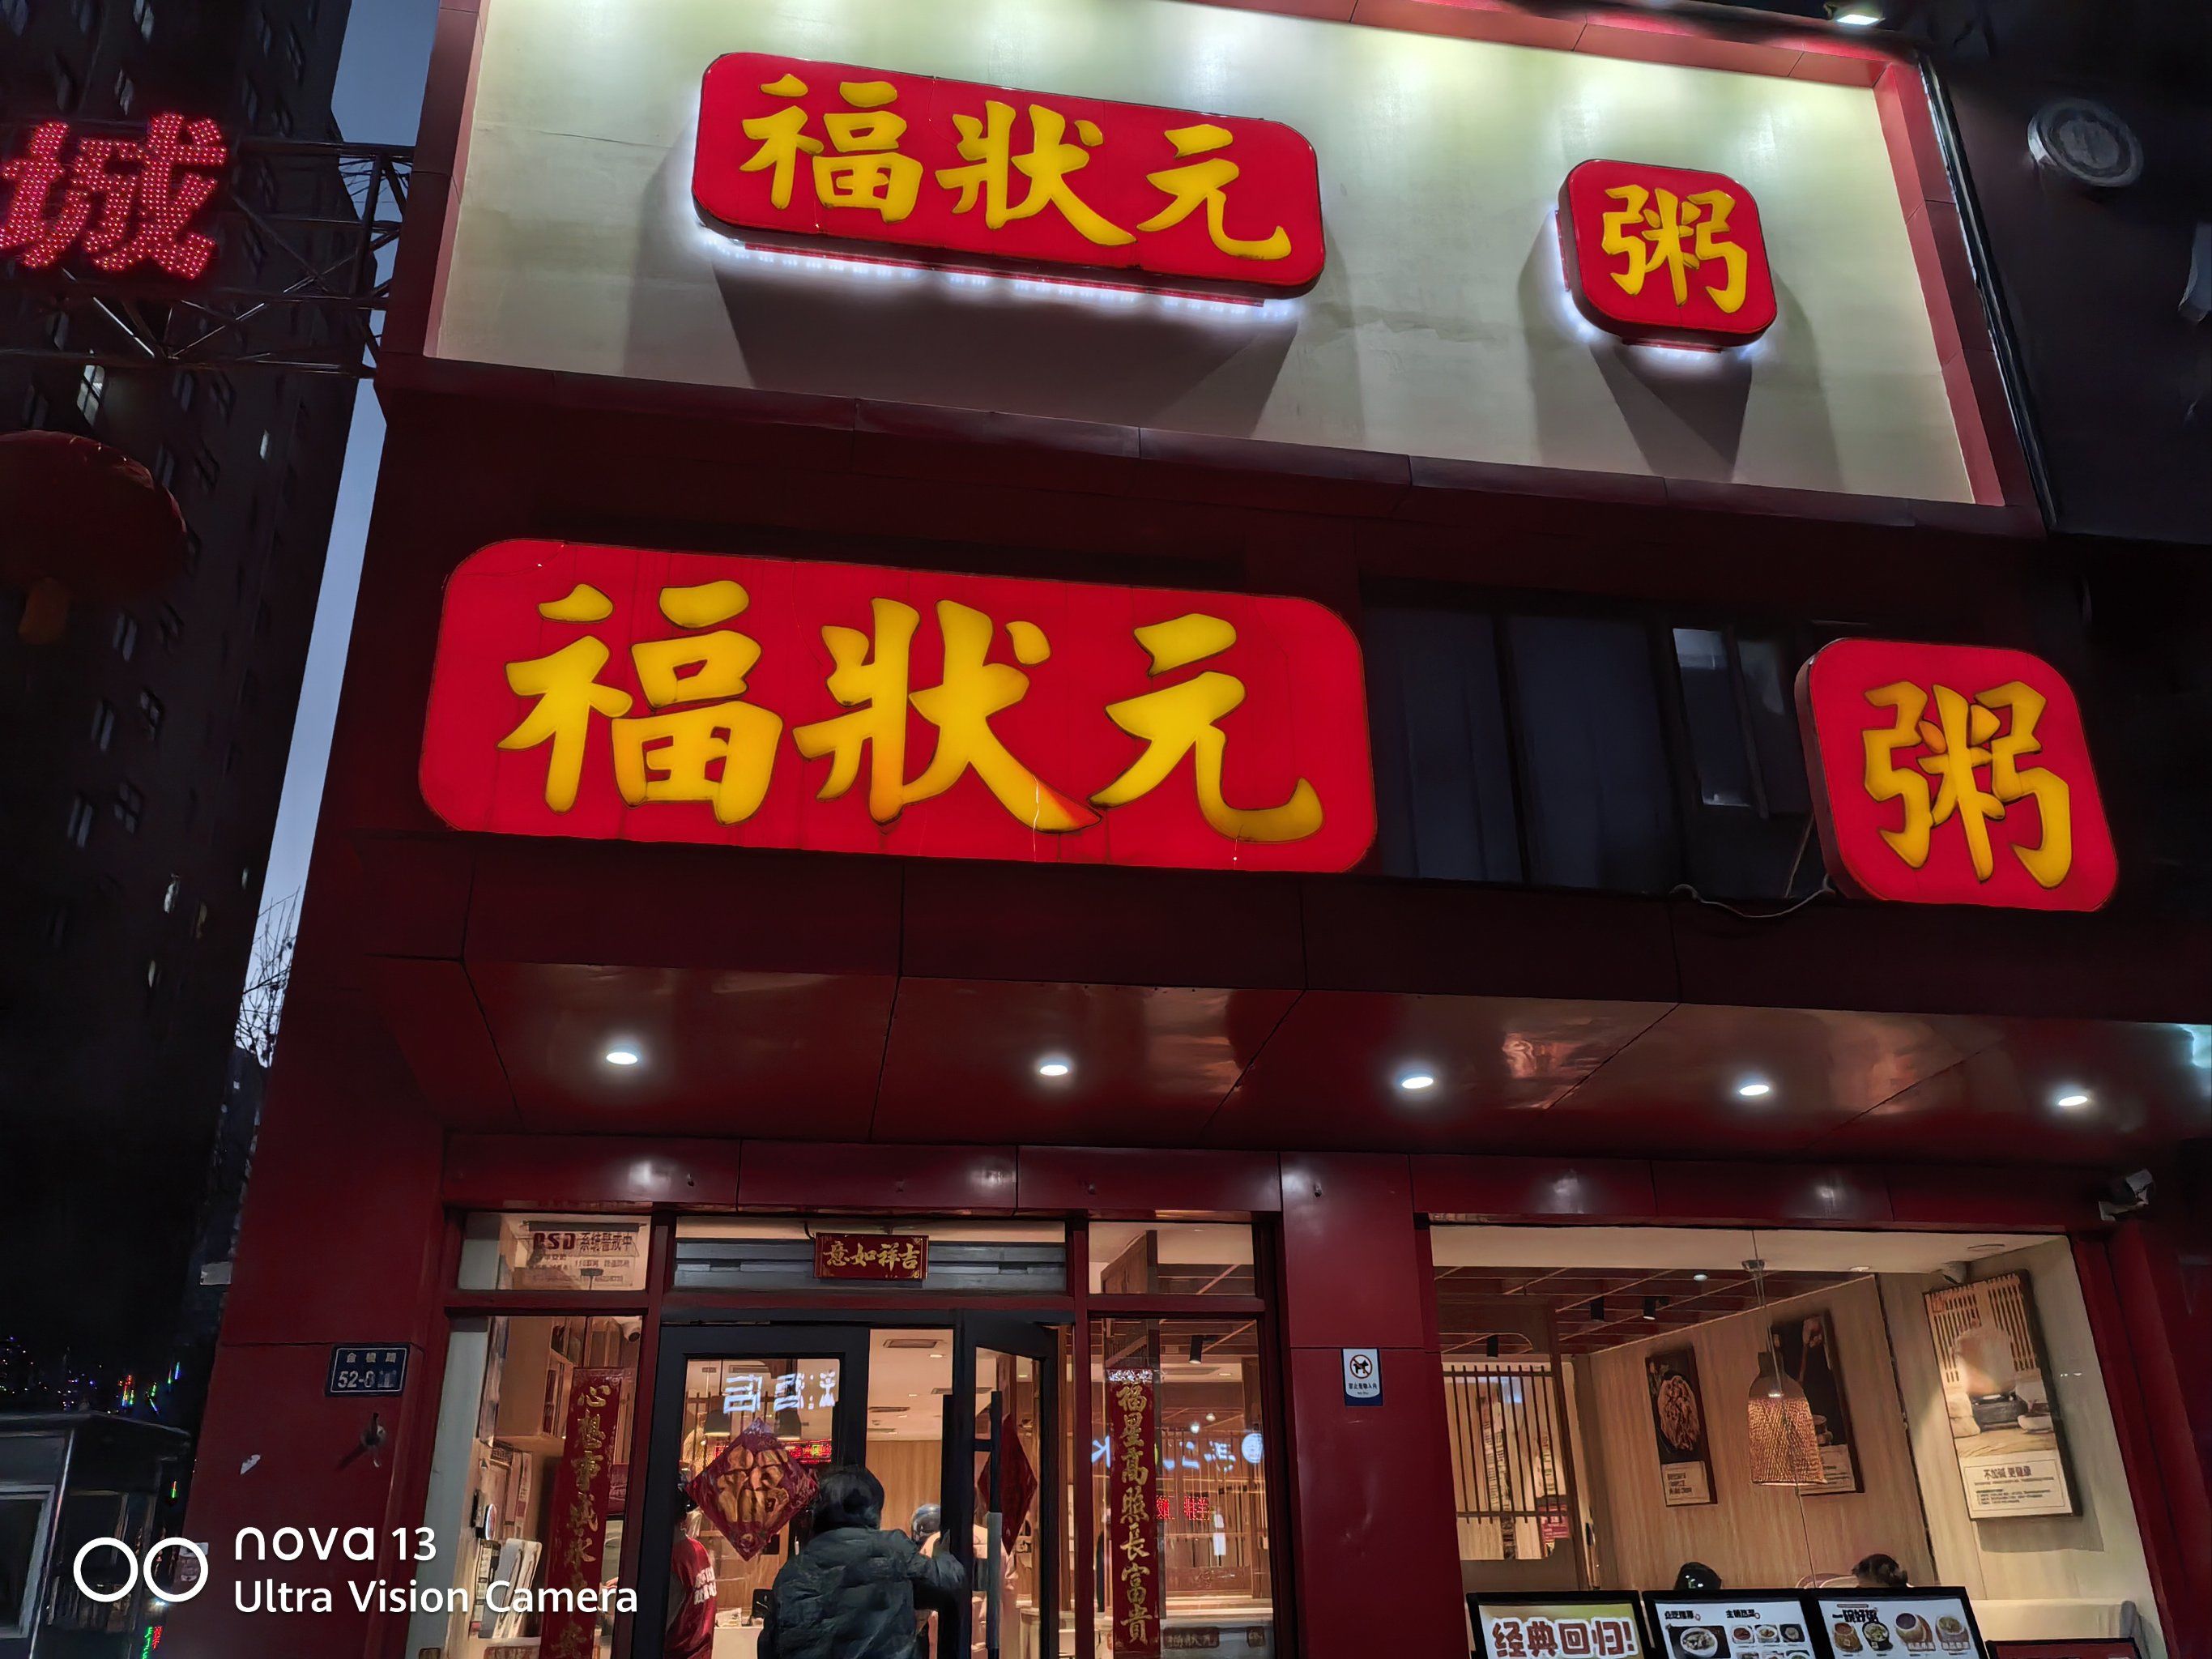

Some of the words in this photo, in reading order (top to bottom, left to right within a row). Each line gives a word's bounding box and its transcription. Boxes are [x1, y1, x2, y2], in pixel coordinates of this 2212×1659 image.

[0, 113, 228, 279] 城
[1601, 183, 1749, 314] 粥
[1862, 680, 2073, 888] 粥
